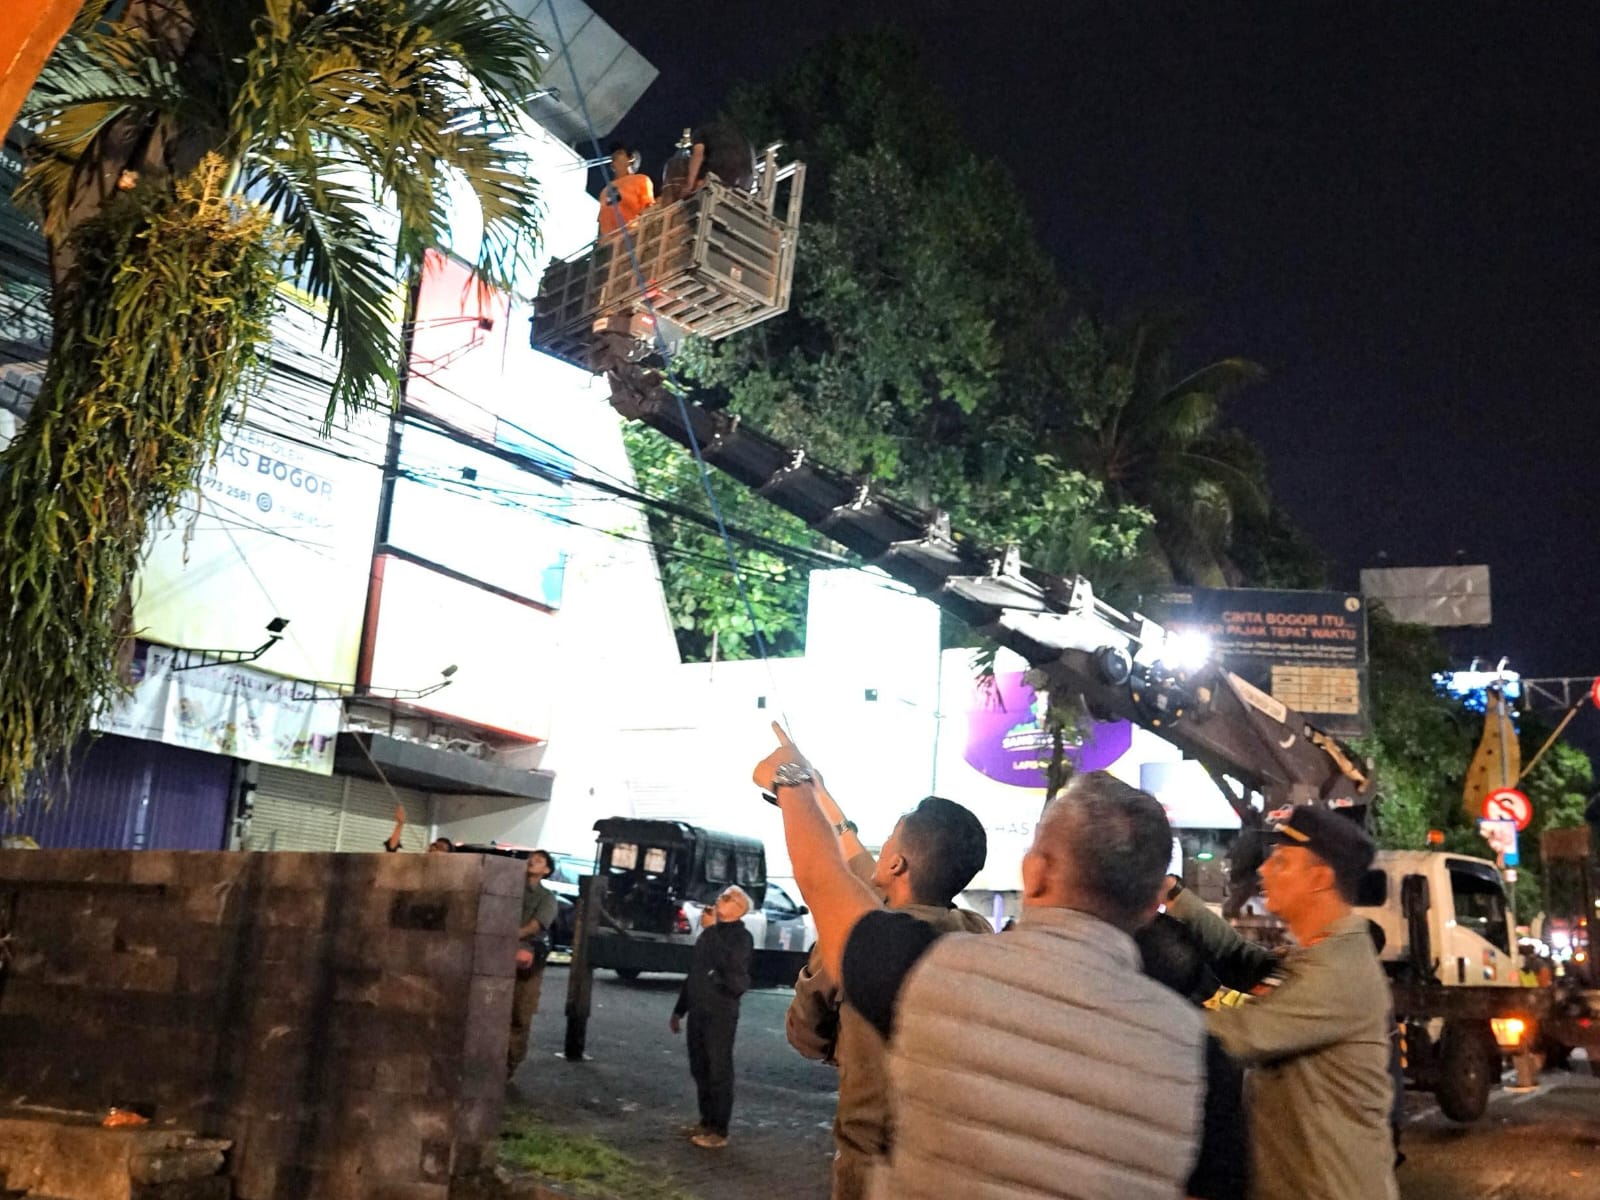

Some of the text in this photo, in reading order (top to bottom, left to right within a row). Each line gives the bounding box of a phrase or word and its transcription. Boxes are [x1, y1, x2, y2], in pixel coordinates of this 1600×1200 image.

[257, 455, 332, 499] BOGOR
[1222, 611, 1262, 624] CINTA
[1265, 612, 1318, 625] BOGOR
[1270, 626, 1307, 637] TEPAT
[1311, 627, 1356, 640] WAKTU
